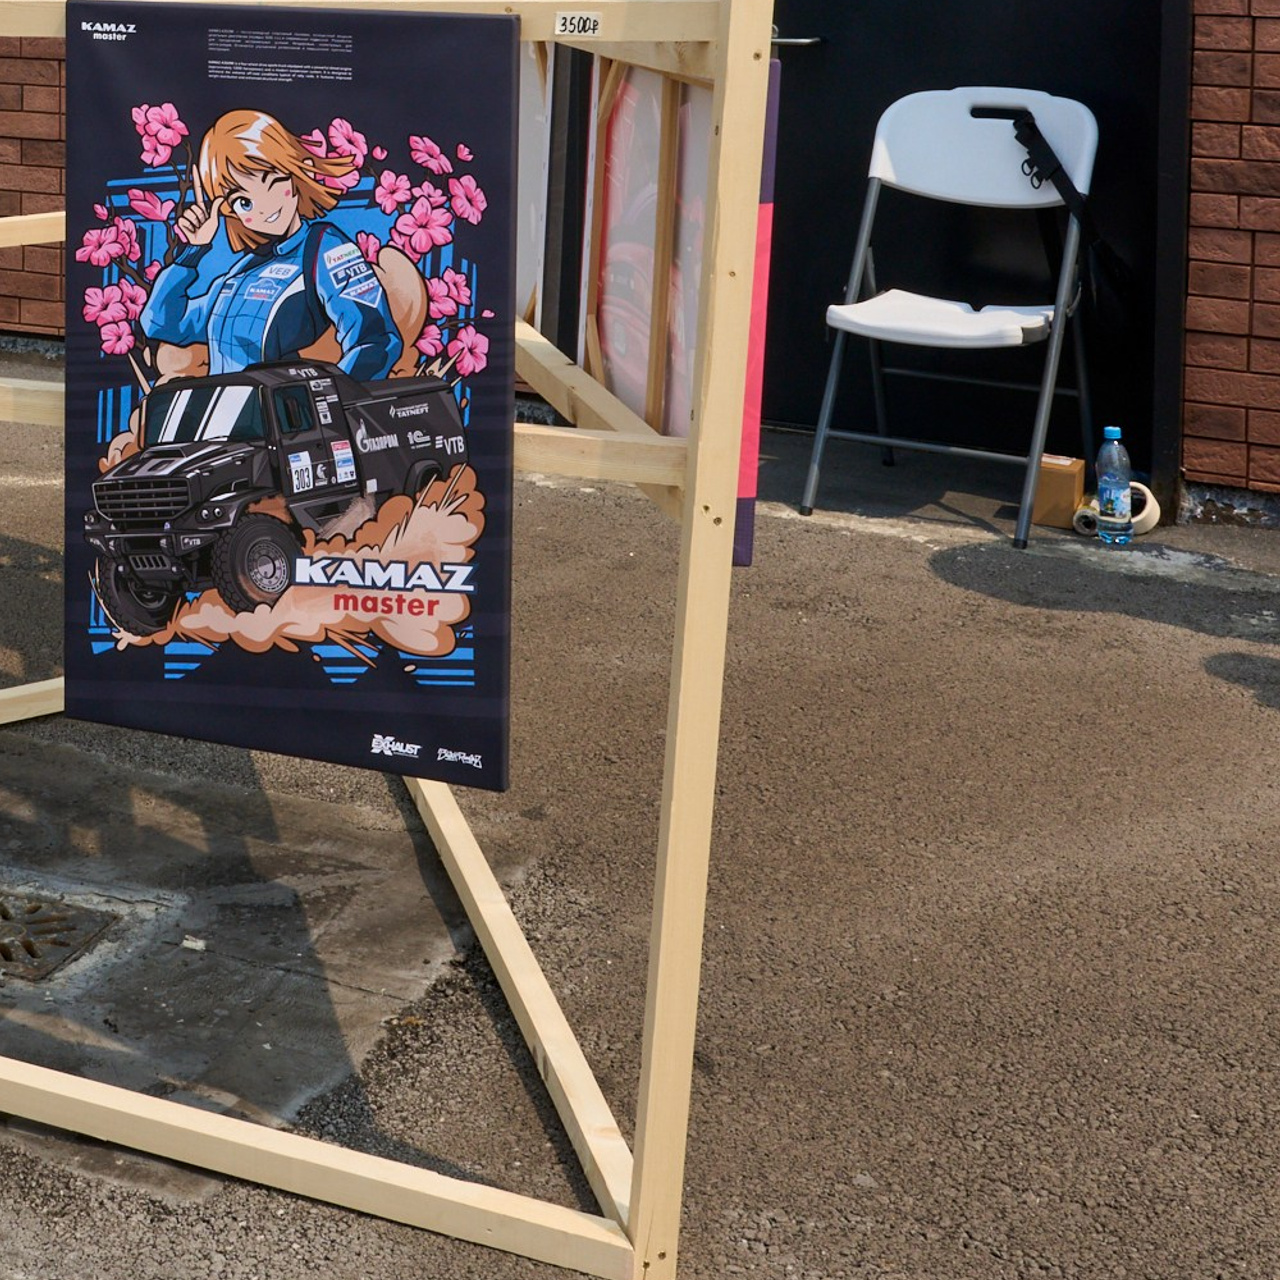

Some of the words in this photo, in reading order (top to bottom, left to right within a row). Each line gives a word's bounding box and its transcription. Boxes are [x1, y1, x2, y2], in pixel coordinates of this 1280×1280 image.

[81, 21, 137, 33] KAMAZ
[93, 33, 127, 41] master
[346, 263, 368, 277] VTB
[298, 368, 318, 378] VTB
[443, 436, 465, 455] VTB
[295, 467, 311, 490] 303
[295, 558, 475, 591] KAMAZ
[334, 594, 440, 616] master
